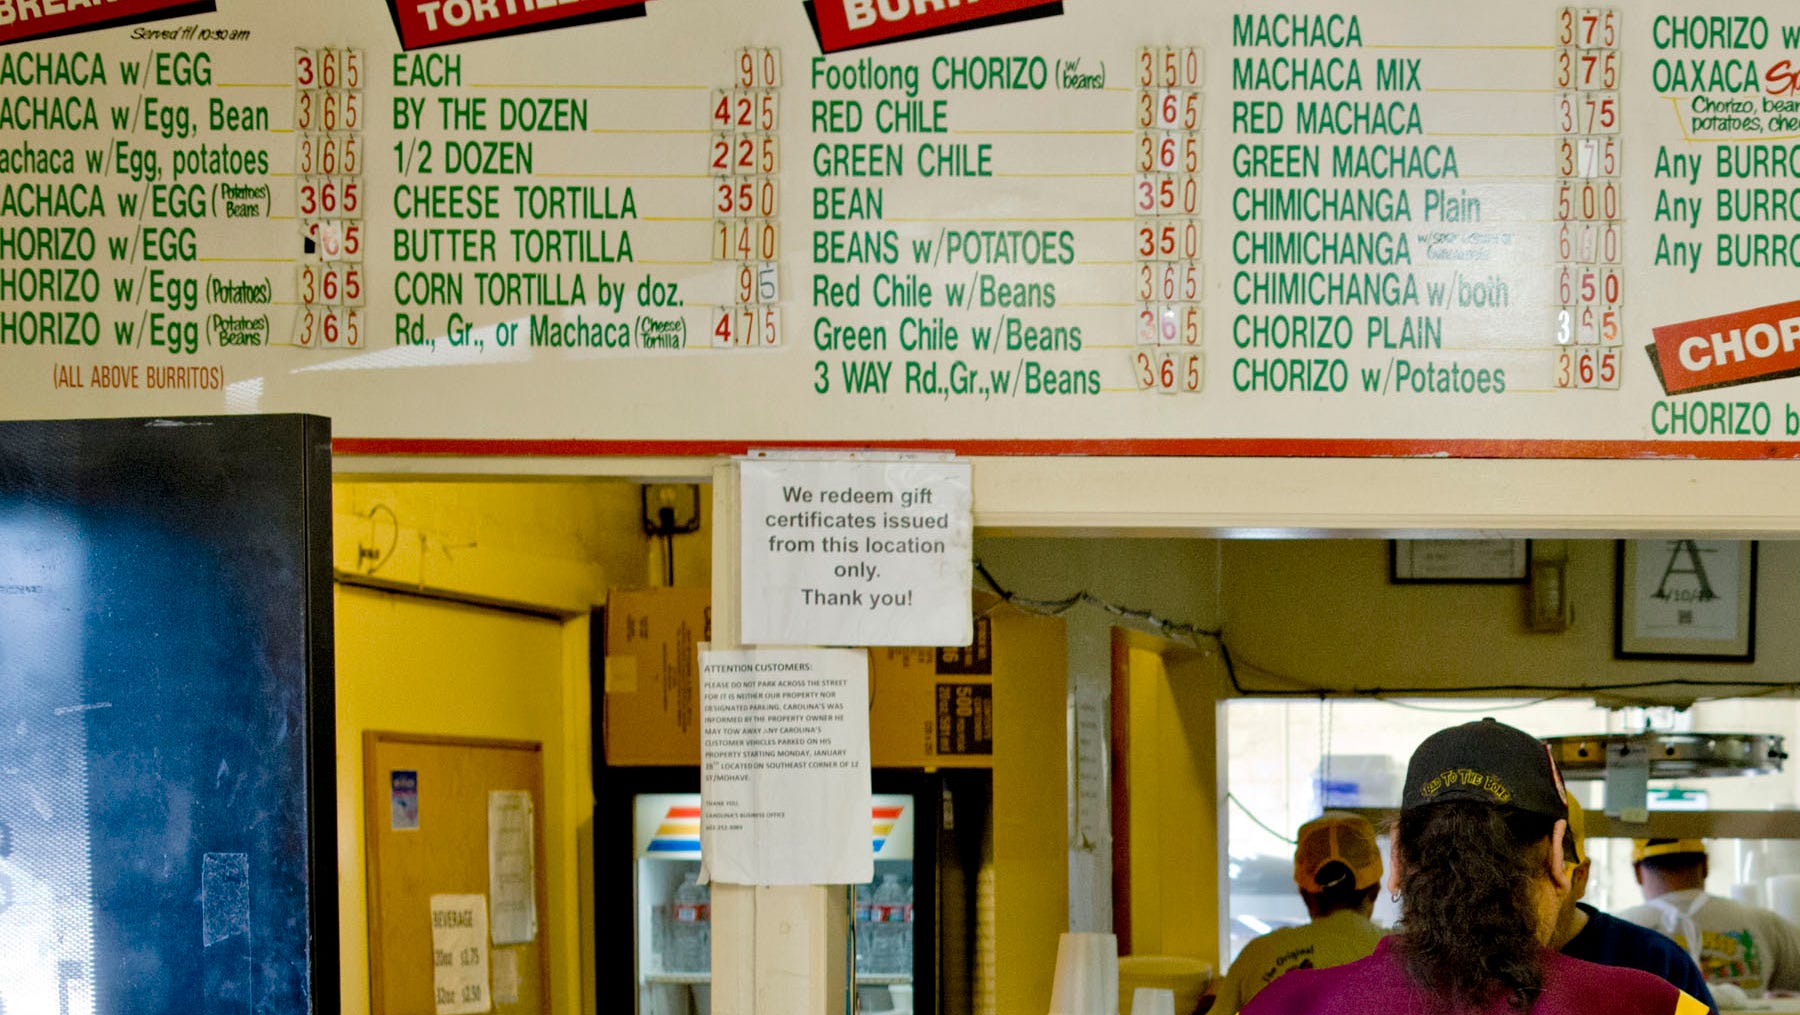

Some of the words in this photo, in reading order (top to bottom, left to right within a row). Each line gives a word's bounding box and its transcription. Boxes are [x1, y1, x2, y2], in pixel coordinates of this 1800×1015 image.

[120, 49, 212, 89] w/EGG
[297, 52, 359, 87] 365
[393, 53, 461, 87] EACH
[811, 57, 918, 97] Footlong
[932, 57, 1047, 89] CHORIZO
[1233, 58, 1362, 91] MACHACA
[1377, 59, 1422, 91] MIX
[1558, 52, 1615, 88] 375
[1652, 59, 1760, 93] OAXACA
[112, 95, 198, 137] w/Egg,
[209, 98, 269, 131] Bean
[393, 97, 424, 130] BY
[439, 97, 486, 130] THE
[501, 98, 587, 131] DOZEN
[714, 95, 774, 131] 425
[811, 101, 862, 133] RED
[876, 100, 947, 133] CHILE
[1140, 94, 1197, 130] 365
[1692, 96, 1757, 114] Chorizo,
[1692, 116, 1763, 132] potatoes,
[173, 142, 268, 180] potatoes
[394, 138, 432, 177] 1/2
[445, 141, 532, 174] DOZEN
[813, 144, 902, 177] GREEN
[917, 144, 992, 177] CHILE
[1655, 146, 1701, 184] Any
[394, 185, 500, 218] CHEESE
[514, 186, 637, 219] TORTILLA
[813, 188, 883, 220] BEAN
[1233, 189, 1412, 222] CHIMICHANGA
[1424, 189, 1480, 222] Plain
[813, 231, 898, 263] BEANS
[913, 228, 1074, 268] w/POTATOES
[207, 277, 272, 305] (Potatoes)
[395, 272, 463, 305] CORN
[475, 273, 586, 306] TORTILLA
[599, 275, 624, 312] by
[637, 274, 684, 307] doz.
[1233, 272, 1419, 306] CHIMICHANGA
[1427, 270, 1508, 309] w/both
[53, 364, 88, 390] (ALL
[91, 366, 143, 389] ABOVE
[147, 366, 224, 390] BURRITOS)
[1652, 402, 1770, 435] CHORIZO
[783, 487, 813, 502] We
[820, 488, 893, 503] redeem
[901, 488, 933, 507] gift
[766, 513, 876, 528] certificates
[884, 513, 949, 529] issued
[769, 537, 815, 552] from
[823, 537, 858, 553] this
[866, 538, 945, 553] location
[834, 563, 880, 581] only.
[1650, 540, 1720, 598] A
[802, 589, 862, 606] Thank
[870, 590, 913, 610] you!
[704, 664, 753, 673] ATTENTION
[755, 663, 812, 672] CUSTOMERS:
[704, 680, 729, 689] PLEASE
[743, 680, 756, 688] NOT
